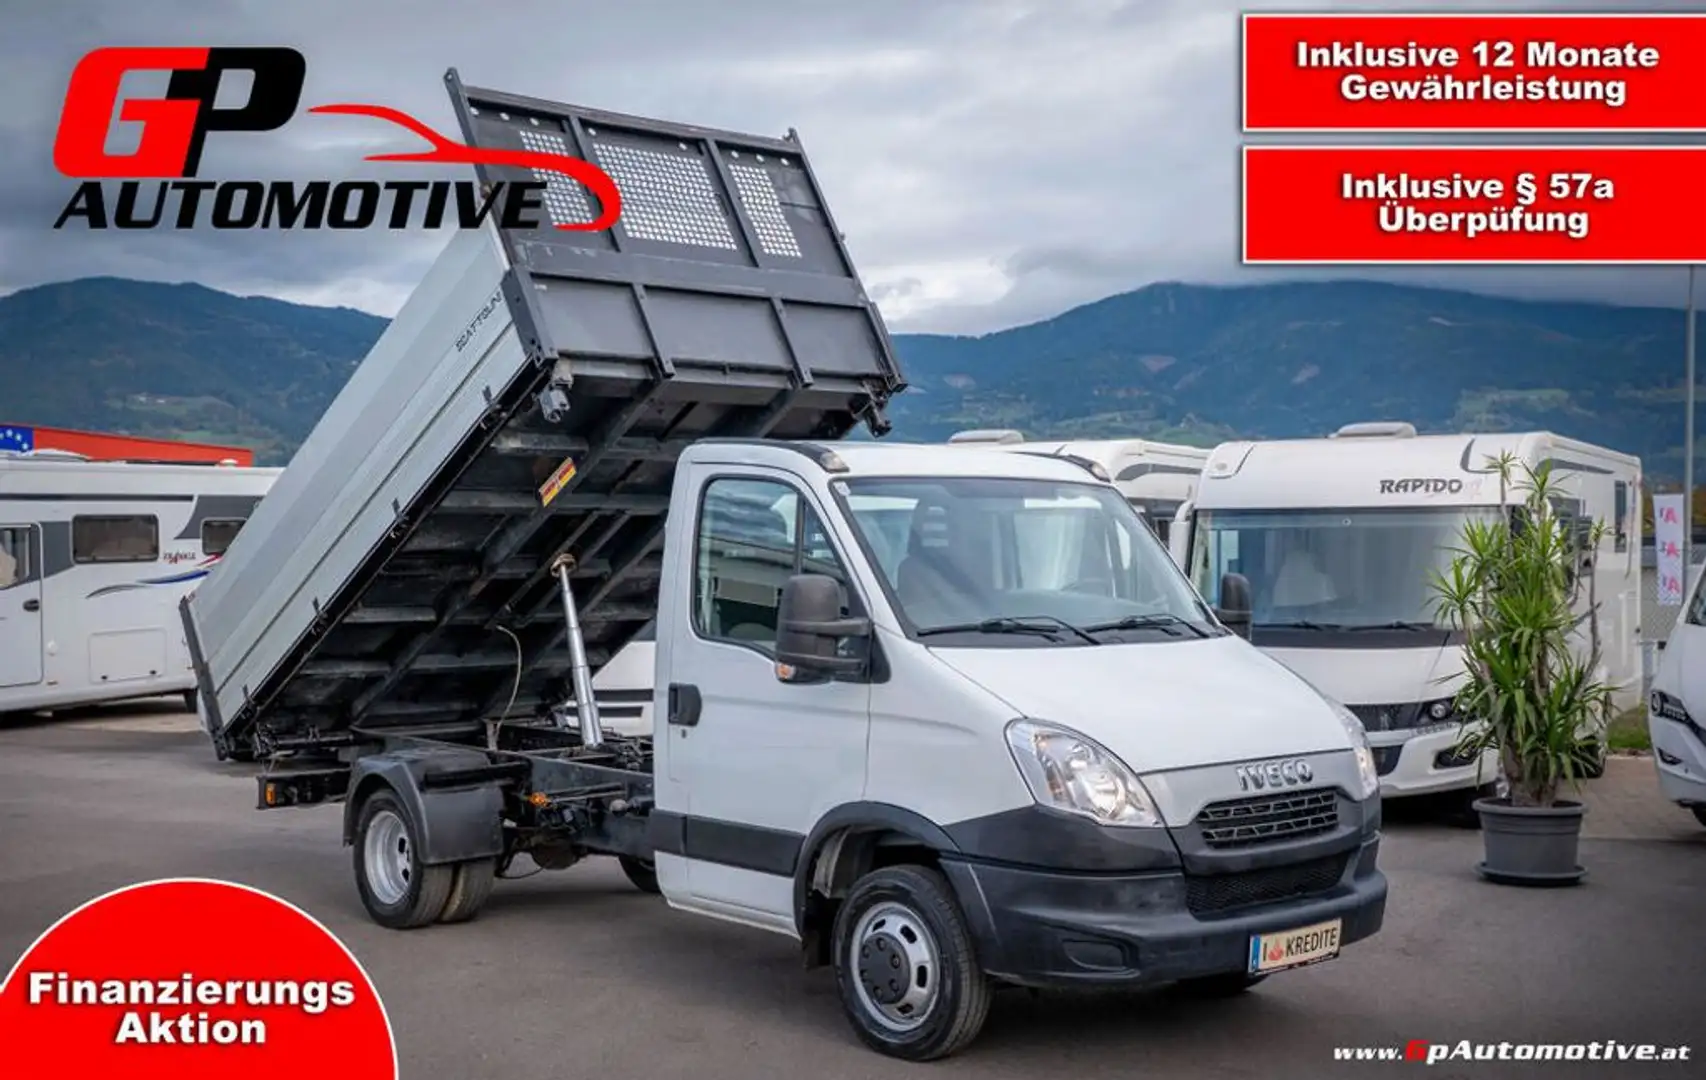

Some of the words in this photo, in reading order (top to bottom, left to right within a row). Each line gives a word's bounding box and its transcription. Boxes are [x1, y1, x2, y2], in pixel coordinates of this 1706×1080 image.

[1379, 478, 1463, 494] RAPIDO
[1236, 759, 1314, 791] IVECO
[1285, 926, 1338, 957] KREDITE
